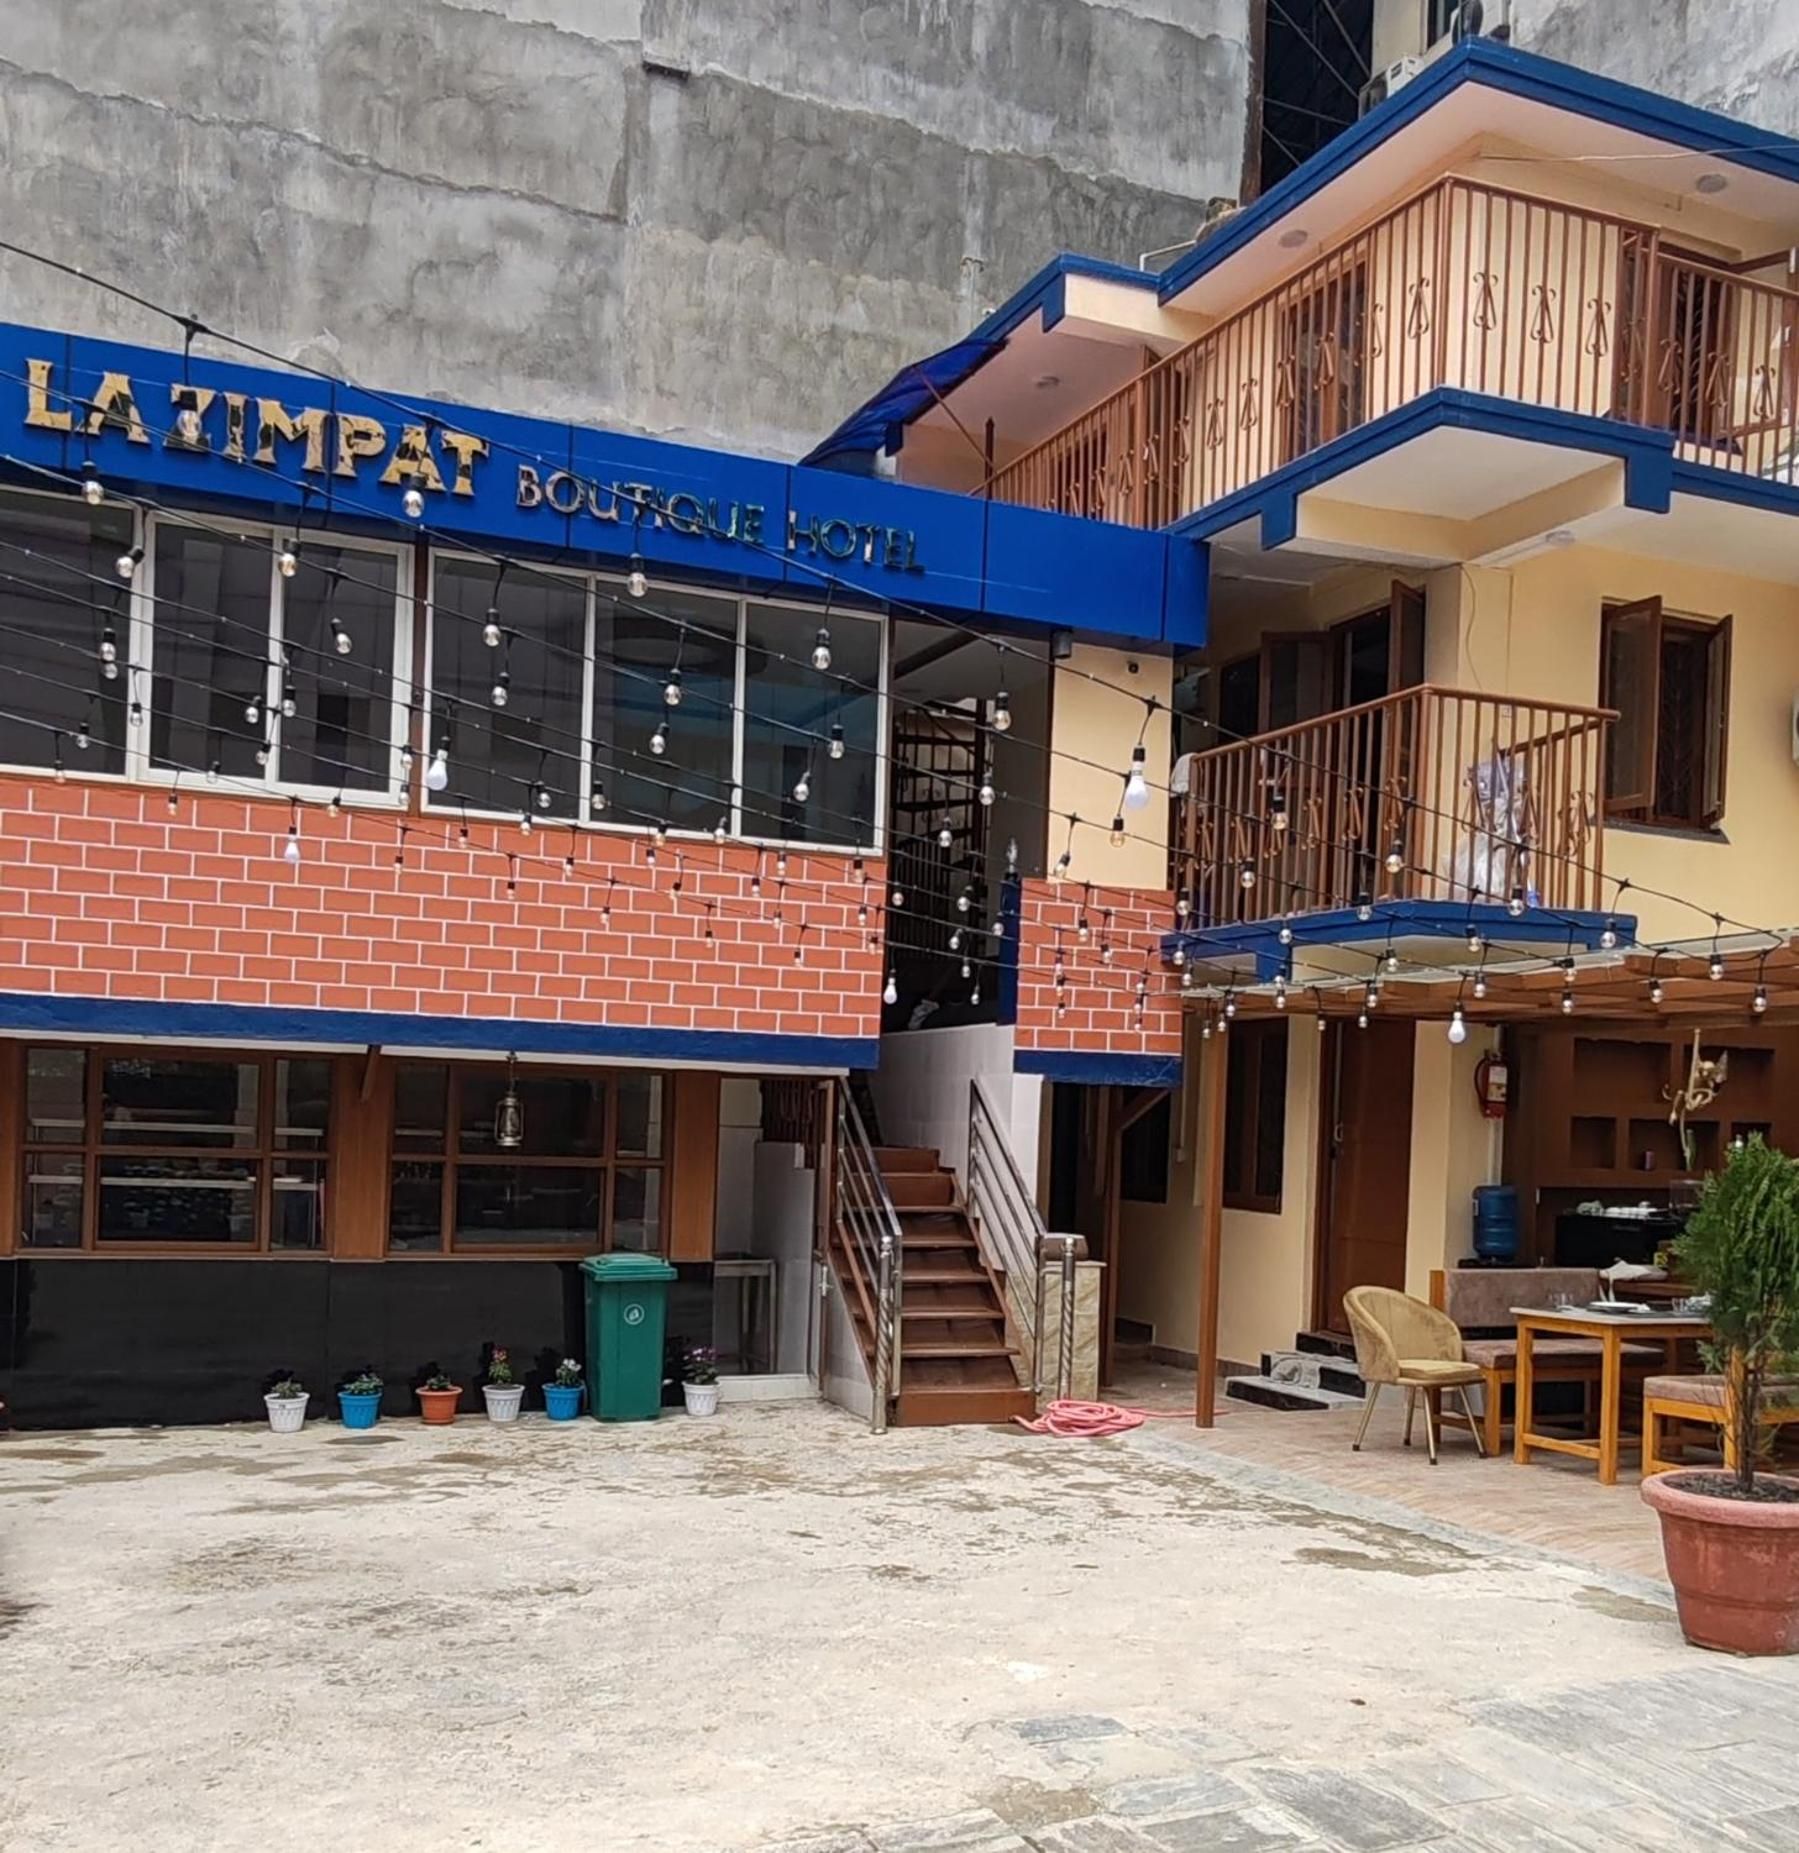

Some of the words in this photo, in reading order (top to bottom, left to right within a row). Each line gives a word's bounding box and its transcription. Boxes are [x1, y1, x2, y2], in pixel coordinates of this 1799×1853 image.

[25, 358, 490, 496] LAZIMPAT
[516, 464, 764, 543] BOUTIQUE
[787, 509, 925, 572] HOTEL
